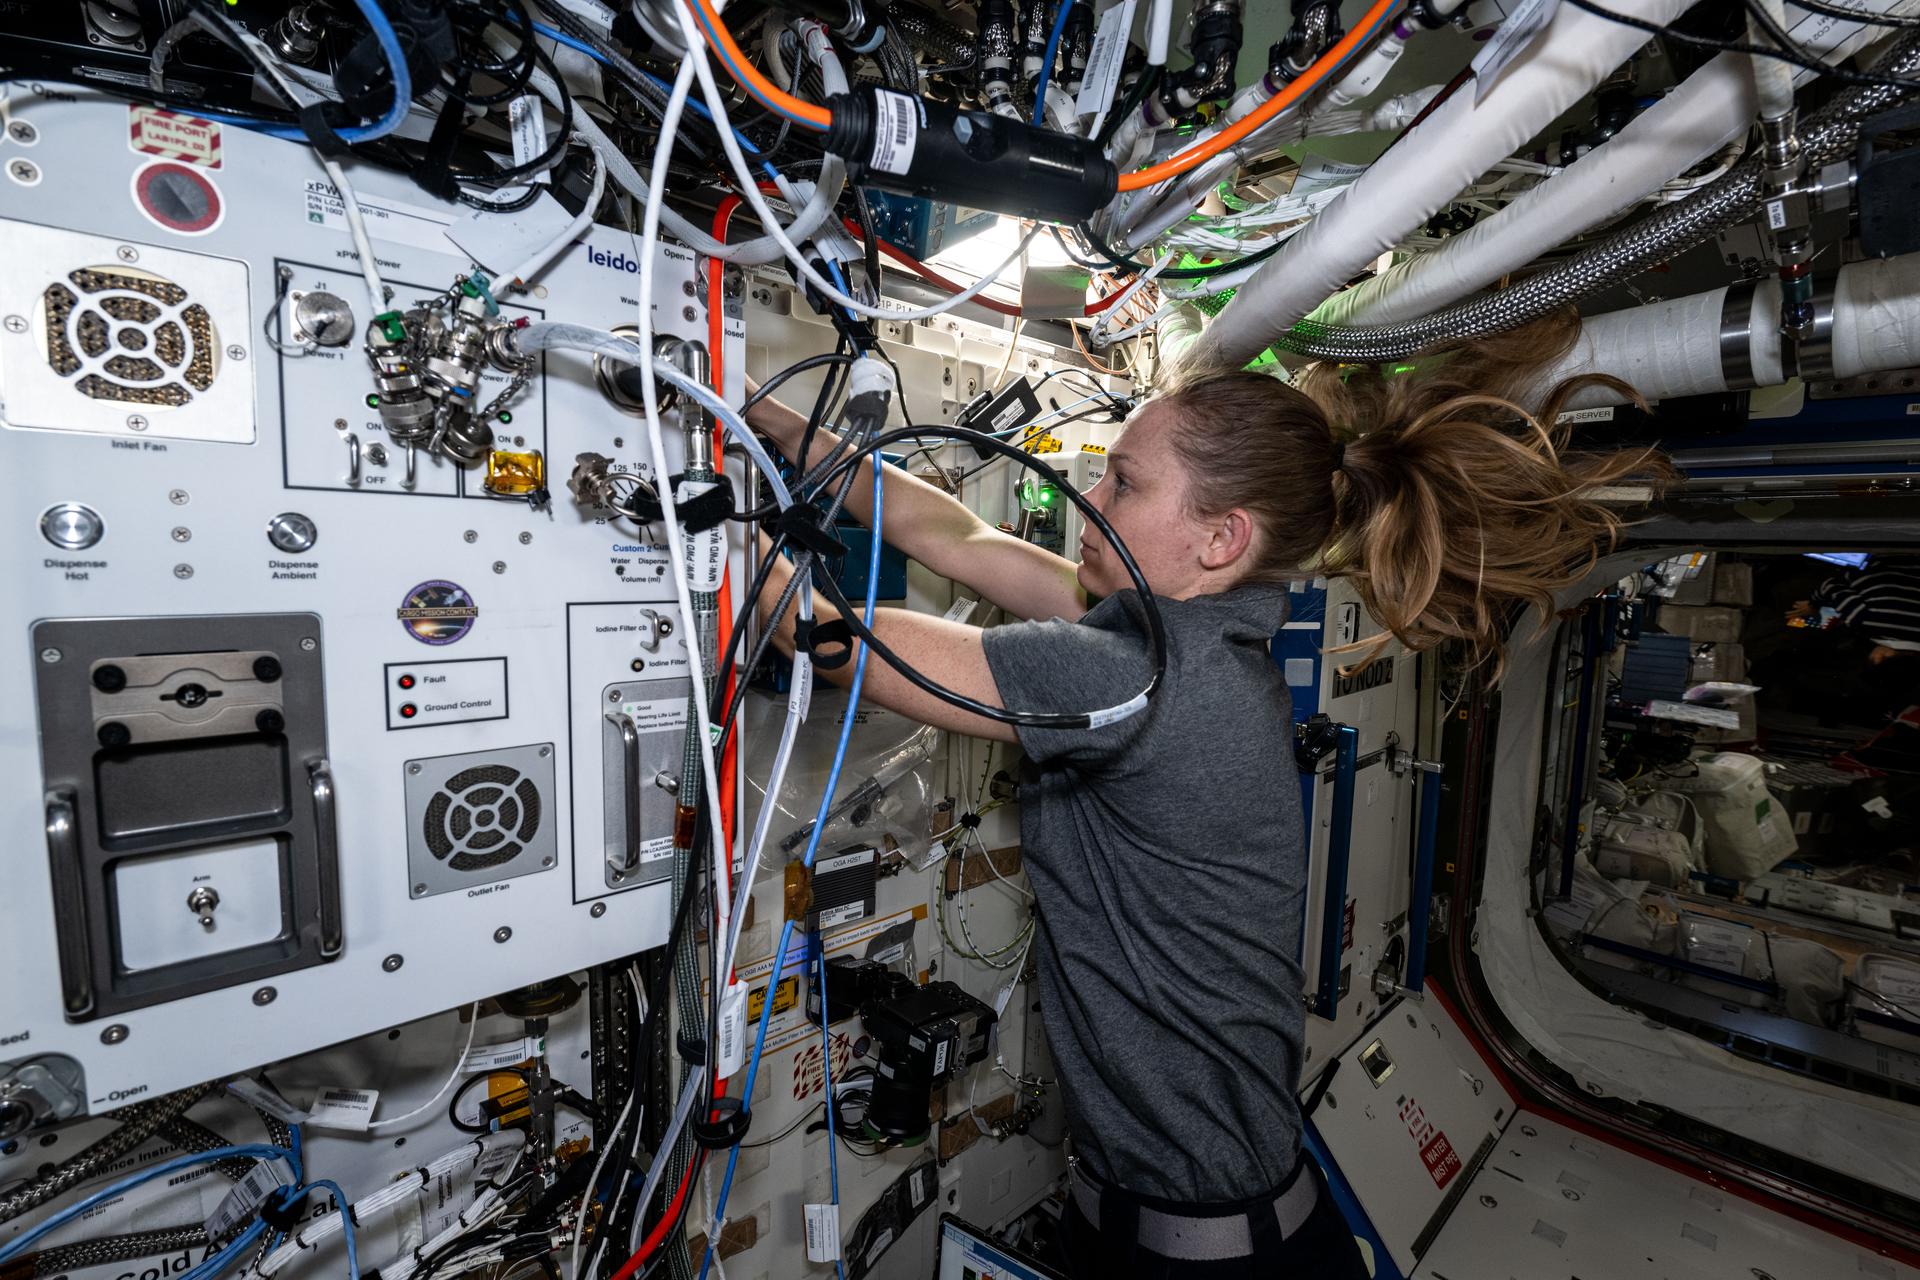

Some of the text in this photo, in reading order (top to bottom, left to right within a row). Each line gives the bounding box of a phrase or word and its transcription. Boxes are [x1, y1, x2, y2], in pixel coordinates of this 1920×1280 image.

[144, 116, 207, 138] FIRE PORT
[588, 244, 641, 275] leido
[664, 248, 686, 261] Open
[315, 281, 326, 290] J1
[724, 329, 745, 339] losed
[1576, 410, 1611, 420] SERVER
[366, 421, 382, 431] ON
[498, 435, 511, 443] ON
[112, 440, 168, 452] Inlet Fan
[613, 464, 628, 472] 125
[633, 463, 647, 471] 150
[365, 475, 387, 484] OFF
[612, 544, 645, 553] Custom
[709, 546, 719, 563] PWD
[44, 558, 108, 569] Dispense
[268, 560, 319, 571] Dispense
[638, 558, 669, 566] Dispense
[65, 570, 90, 581] Hot
[271, 571, 317, 580] Ambient
[421, 609, 446, 617] MISSION
[446, 608, 476, 616] CONTRACT
[424, 675, 446, 683] Fault
[424, 699, 492, 712] Ground Control
[467, 883, 510, 897] Outlet Fan
[807, 1063, 821, 1076] FIRE
[108, 1084, 148, 1103] Open
[1425, 1138, 1448, 1165] WATER
[1432, 1160, 1449, 1182] MIST
